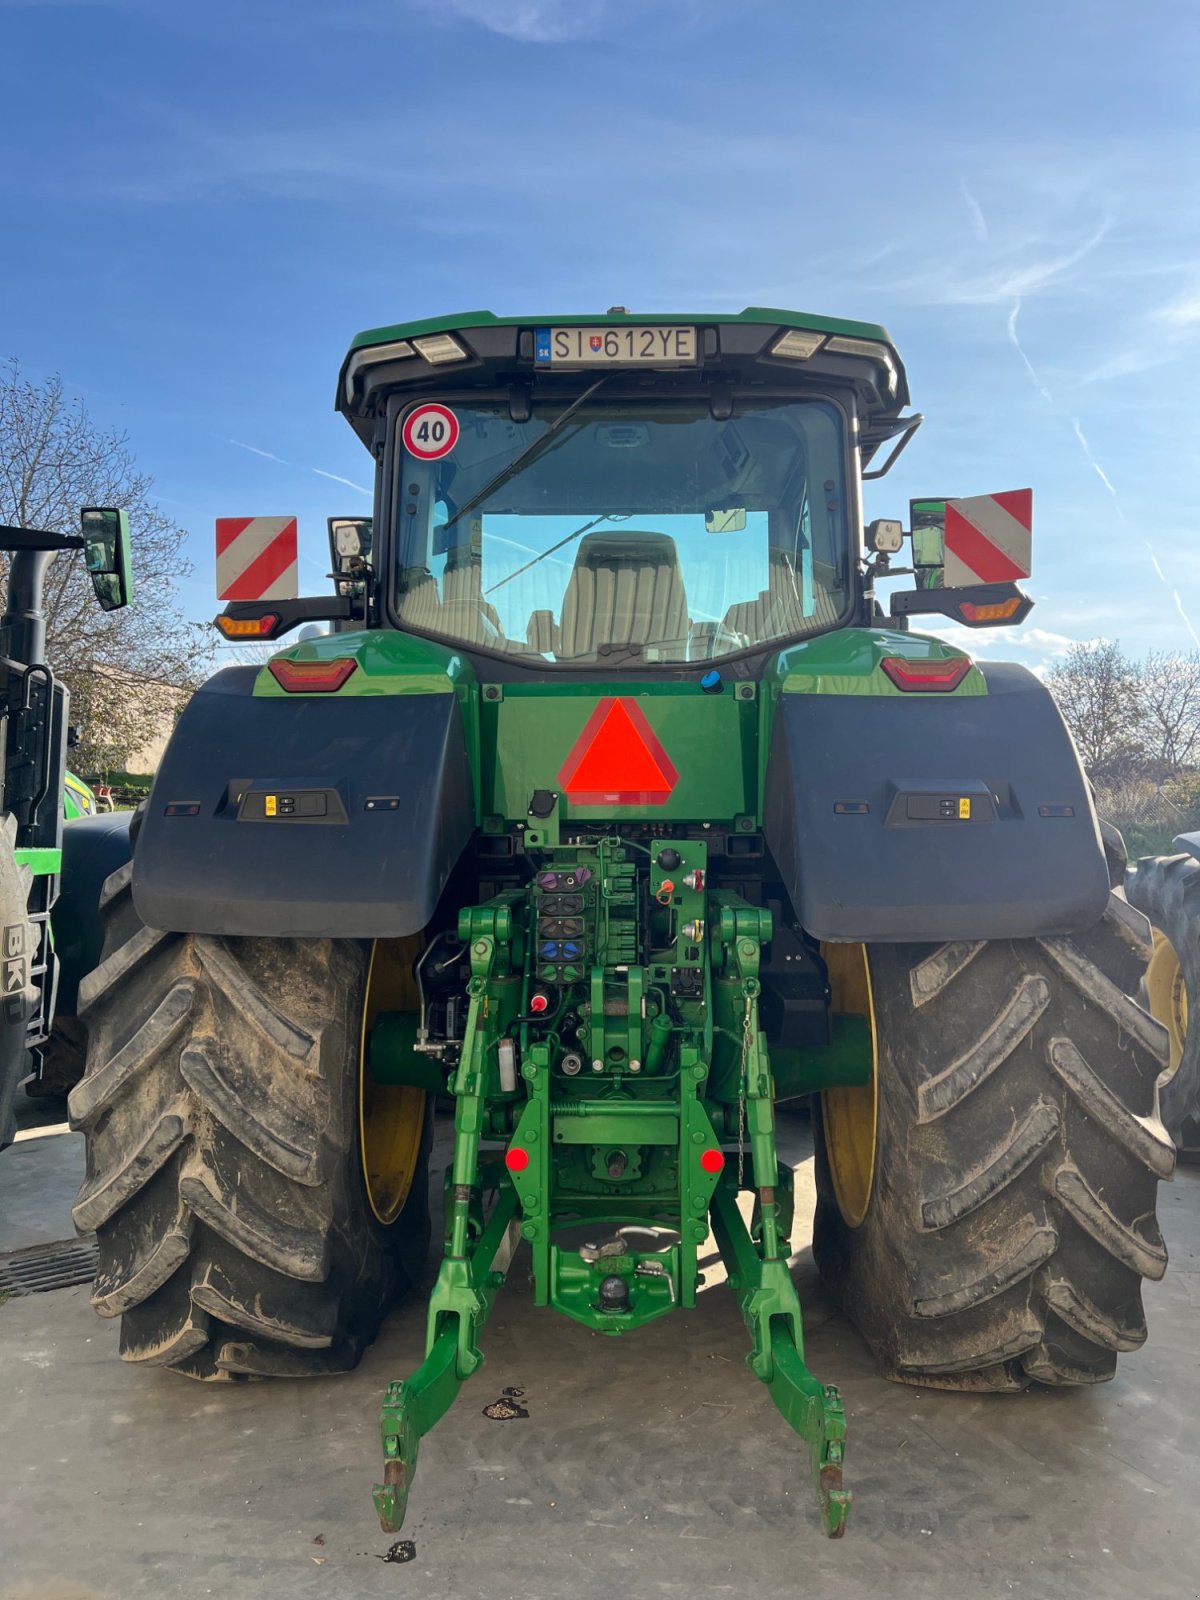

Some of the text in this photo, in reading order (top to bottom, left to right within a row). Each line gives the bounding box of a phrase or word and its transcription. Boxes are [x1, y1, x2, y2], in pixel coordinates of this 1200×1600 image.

[539, 348, 549, 357] SK
[554, 329, 691, 358] SI 612YE
[416, 420, 445, 443] 40
[7, 925, 25, 1020] BKT
